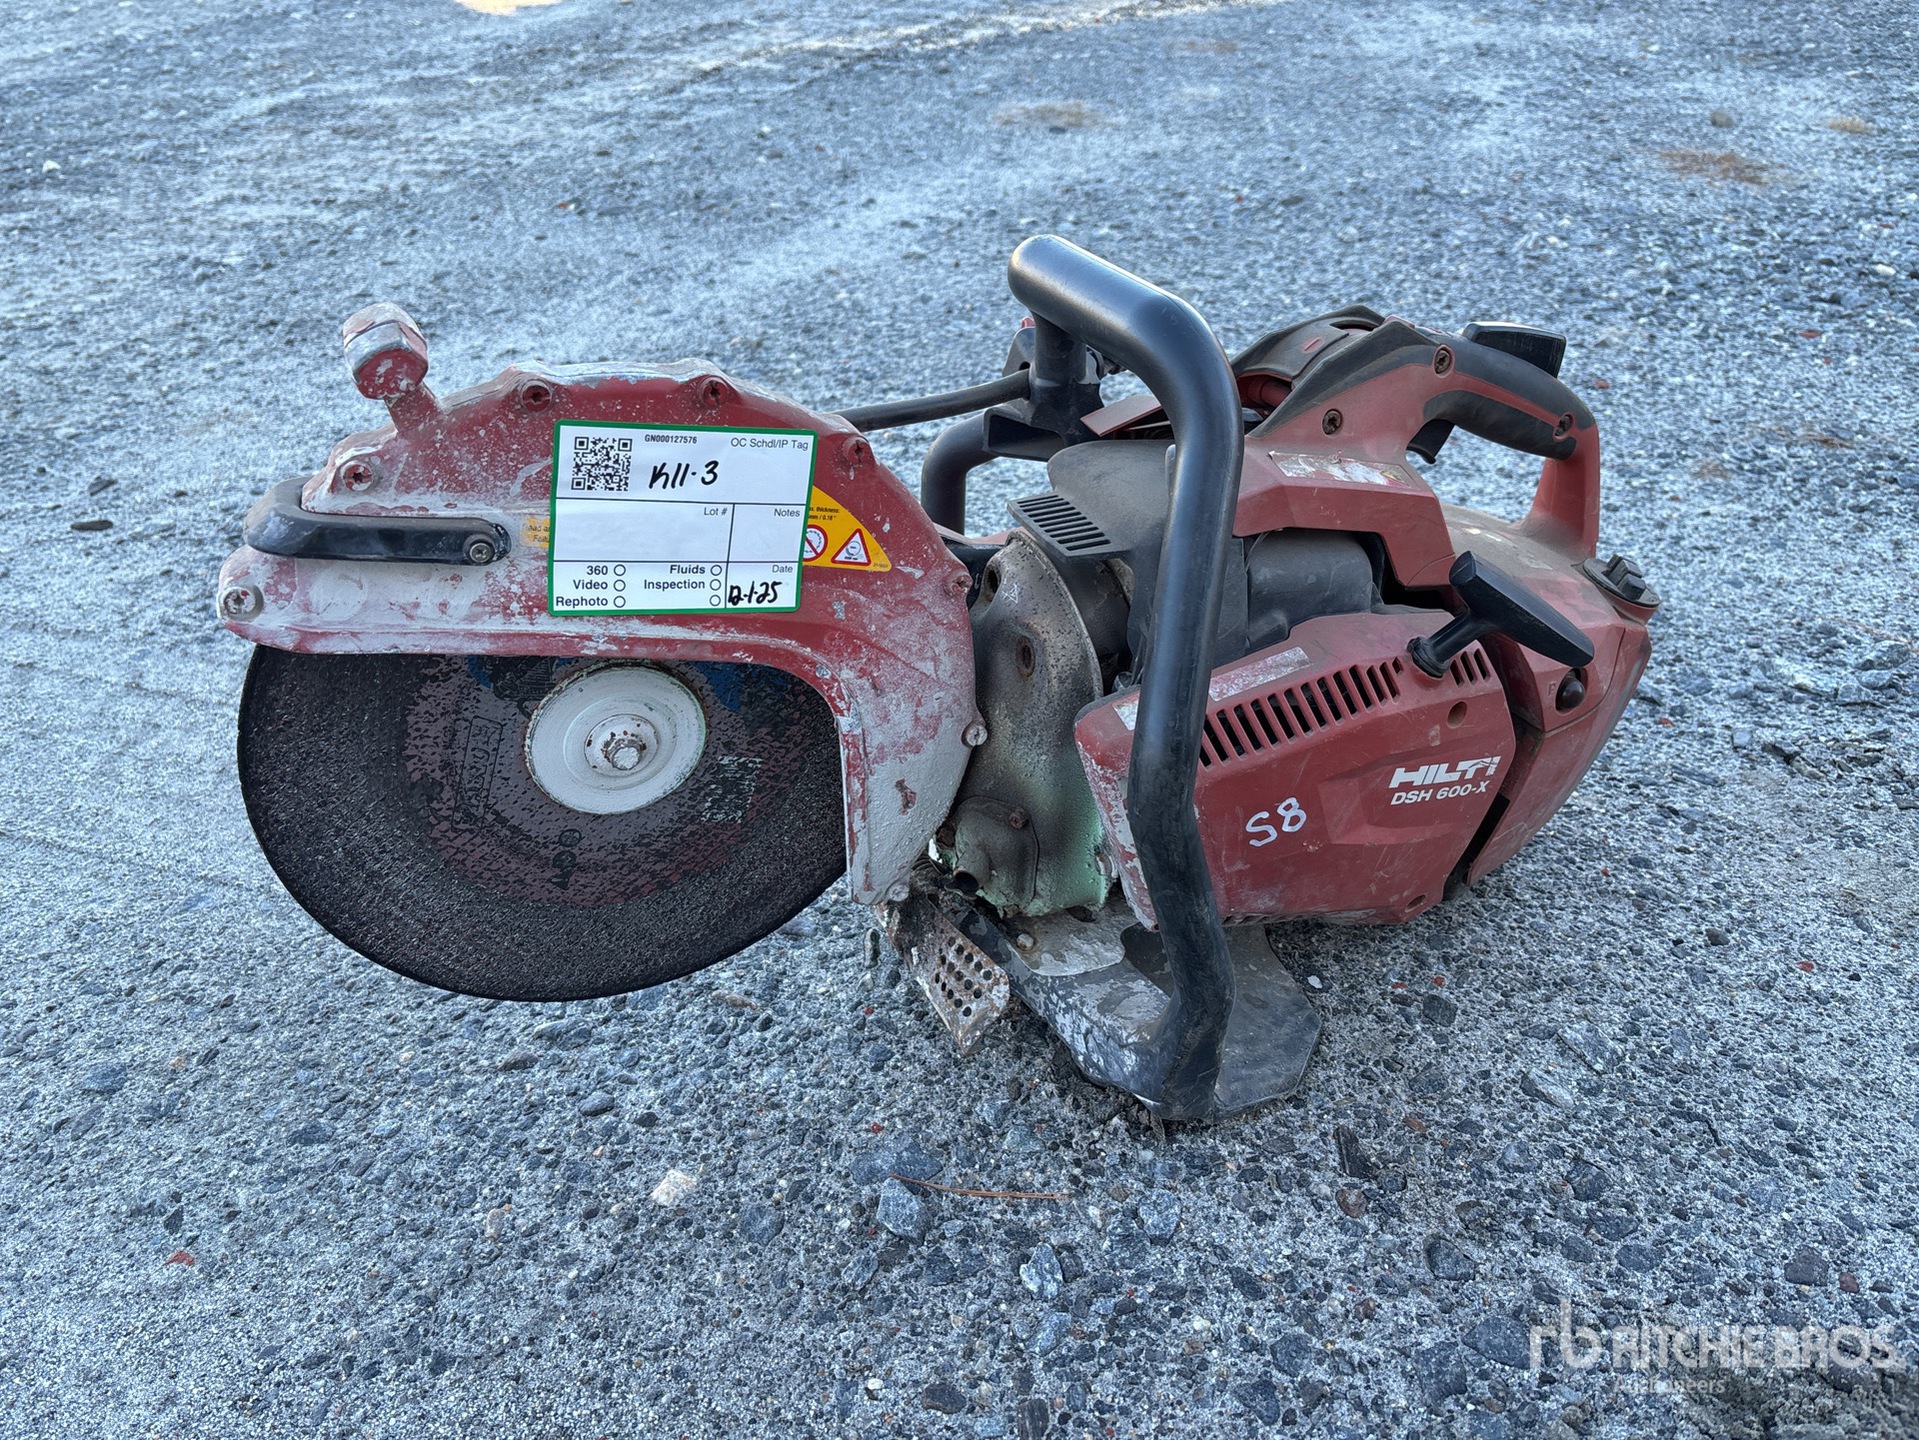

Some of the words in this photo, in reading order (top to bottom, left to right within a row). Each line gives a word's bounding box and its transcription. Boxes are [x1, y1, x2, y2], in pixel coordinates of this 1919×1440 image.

[644, 434, 698, 444] GN000127576
[730, 437, 747, 448] OC
[749, 438, 789, 449] Schdl/IP
[791, 440, 809, 451] Tag
[703, 507, 719, 516] Lot
[721, 507, 728, 516] #
[773, 508, 801, 518] Notes
[586, 565, 609, 576] 360
[669, 564, 706, 575] Fluids
[771, 564, 793, 574] Date
[572, 579, 609, 590] Video
[643, 579, 706, 592] Inspection
[555, 596, 609, 609] Rephoto
[1388, 755, 1501, 789] HILTI
[1390, 788, 1432, 806] DSH
[1436, 780, 1491, 800] 600-X
